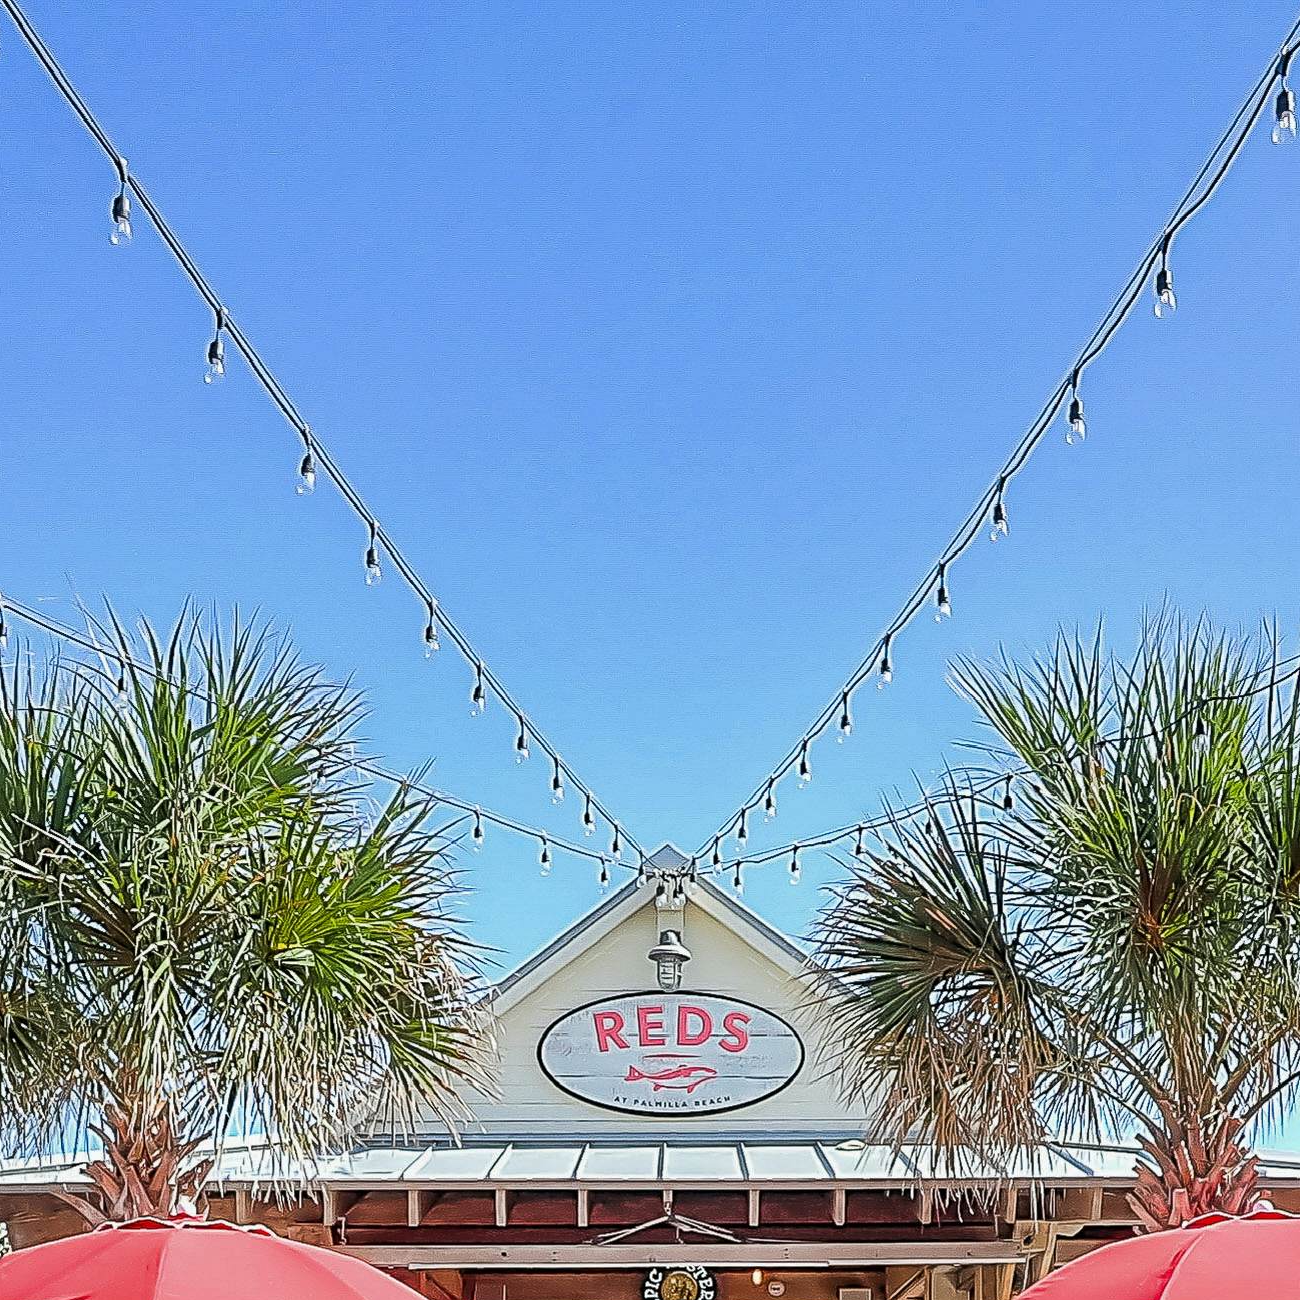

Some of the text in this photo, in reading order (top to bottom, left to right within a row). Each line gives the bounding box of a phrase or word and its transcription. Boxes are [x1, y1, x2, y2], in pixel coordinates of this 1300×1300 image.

[593, 1004, 752, 1053] REDS
[614, 1096, 731, 1108] AT PALMILLA BEACH
